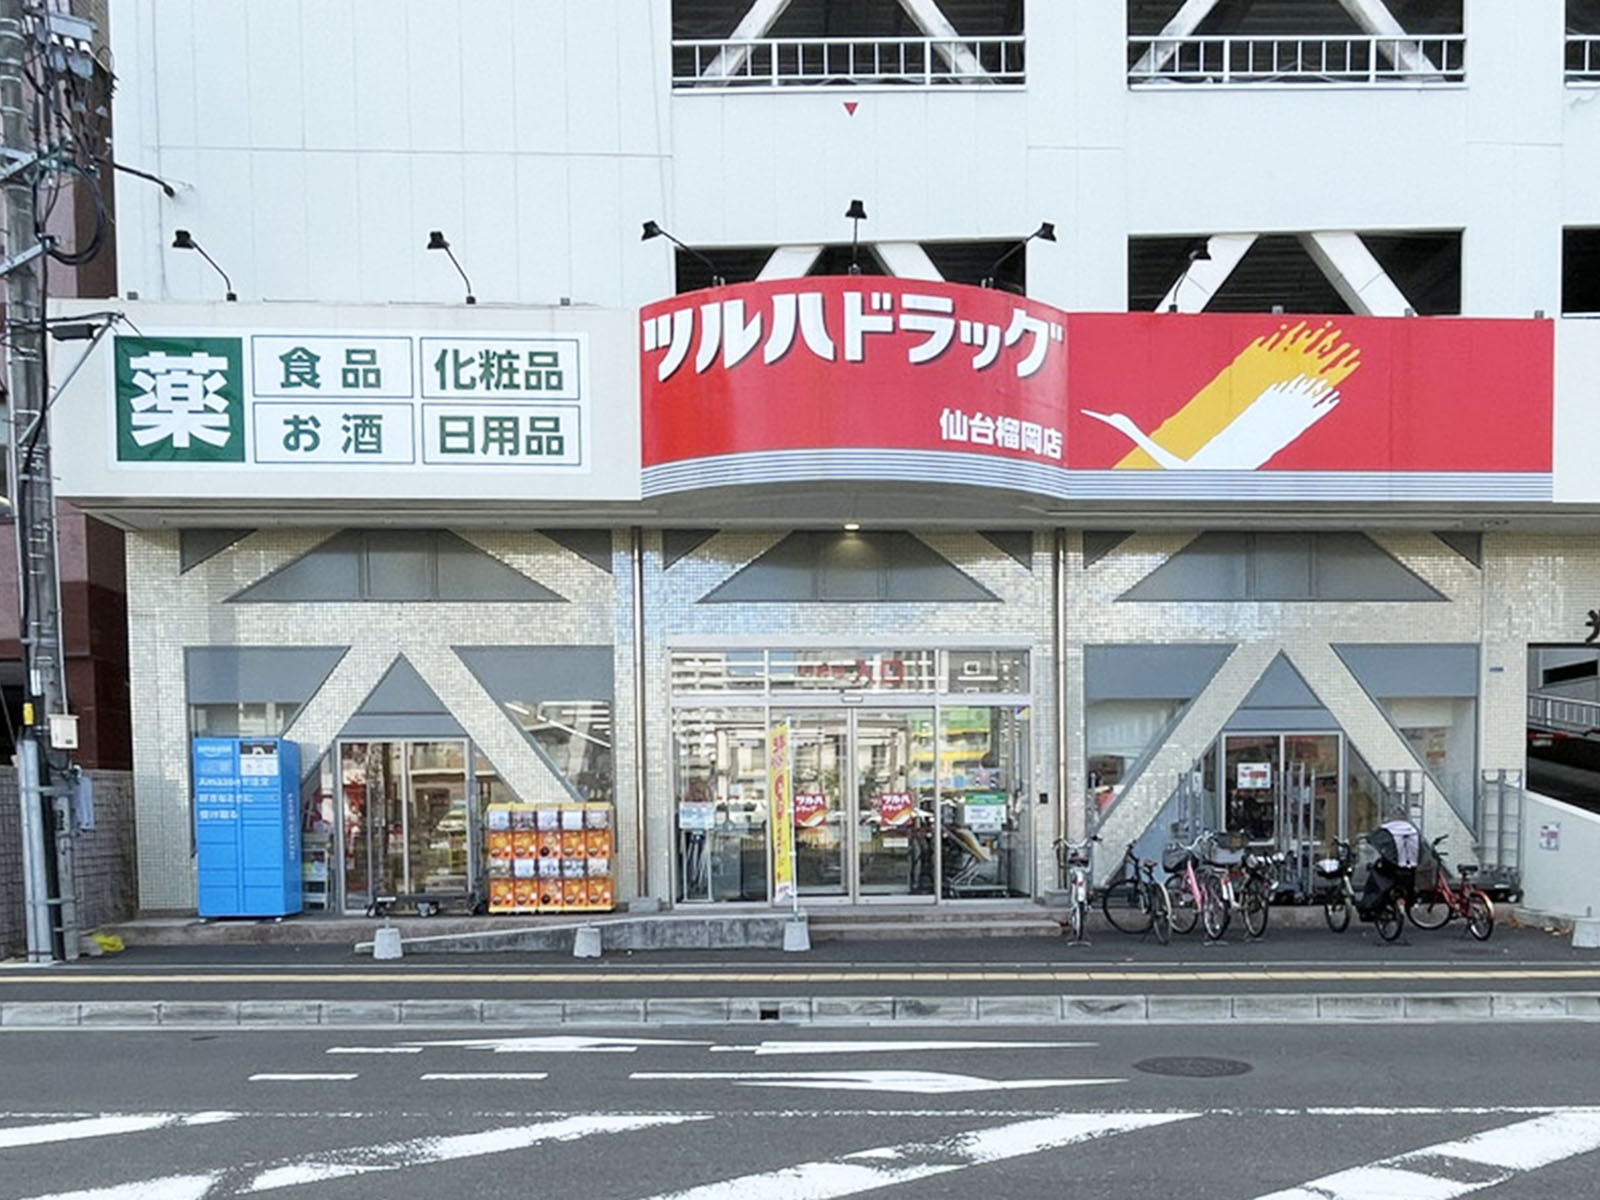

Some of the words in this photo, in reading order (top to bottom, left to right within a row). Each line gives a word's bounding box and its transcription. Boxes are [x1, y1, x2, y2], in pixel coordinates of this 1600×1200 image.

[642, 291, 1065, 383] ツルハドラッグ
[278, 346, 383, 390] 食品
[434, 349, 564, 392] 化粧品
[128, 351, 231, 449] 薬
[282, 413, 384, 455] お酒
[438, 415, 566, 457] 日用品
[939, 407, 1063, 461] 仙台榴岡店
